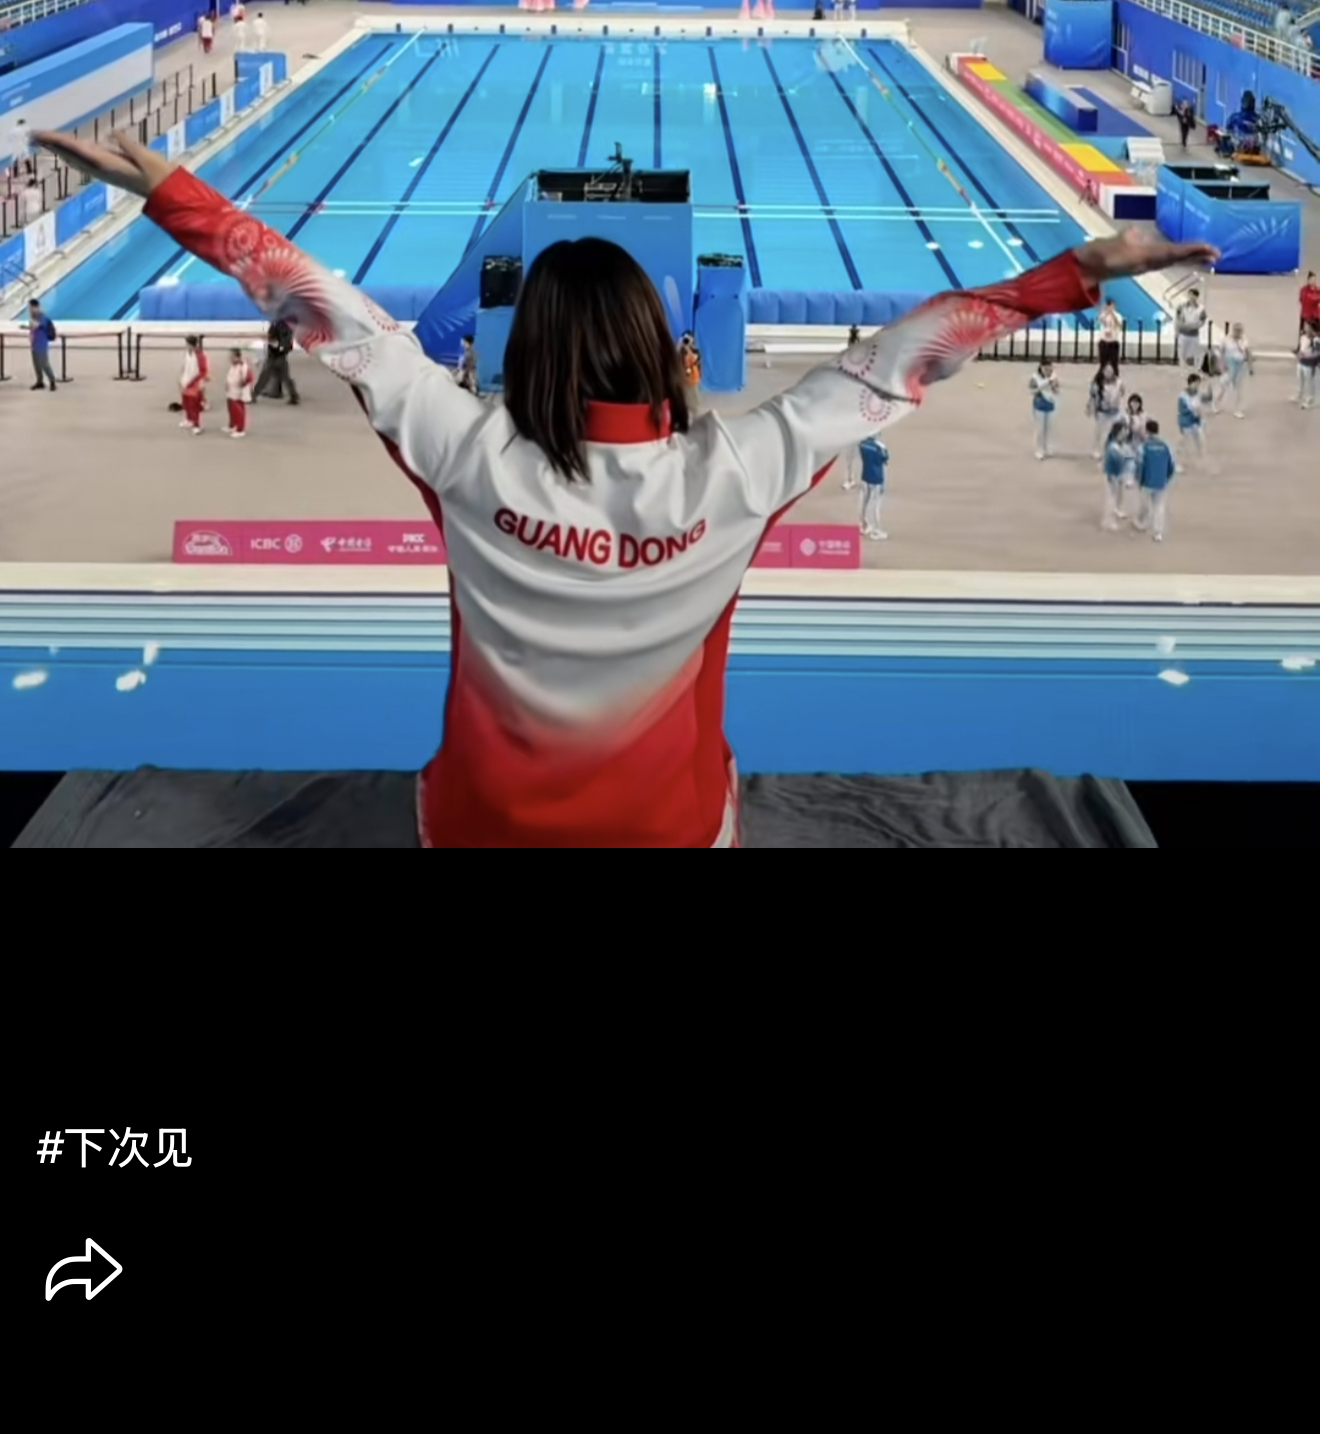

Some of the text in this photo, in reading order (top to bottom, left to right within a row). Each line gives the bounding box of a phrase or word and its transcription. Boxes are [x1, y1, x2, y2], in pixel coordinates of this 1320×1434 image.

[250, 537, 281, 550] ICBC
[494, 507, 707, 569] GUANG DONG
